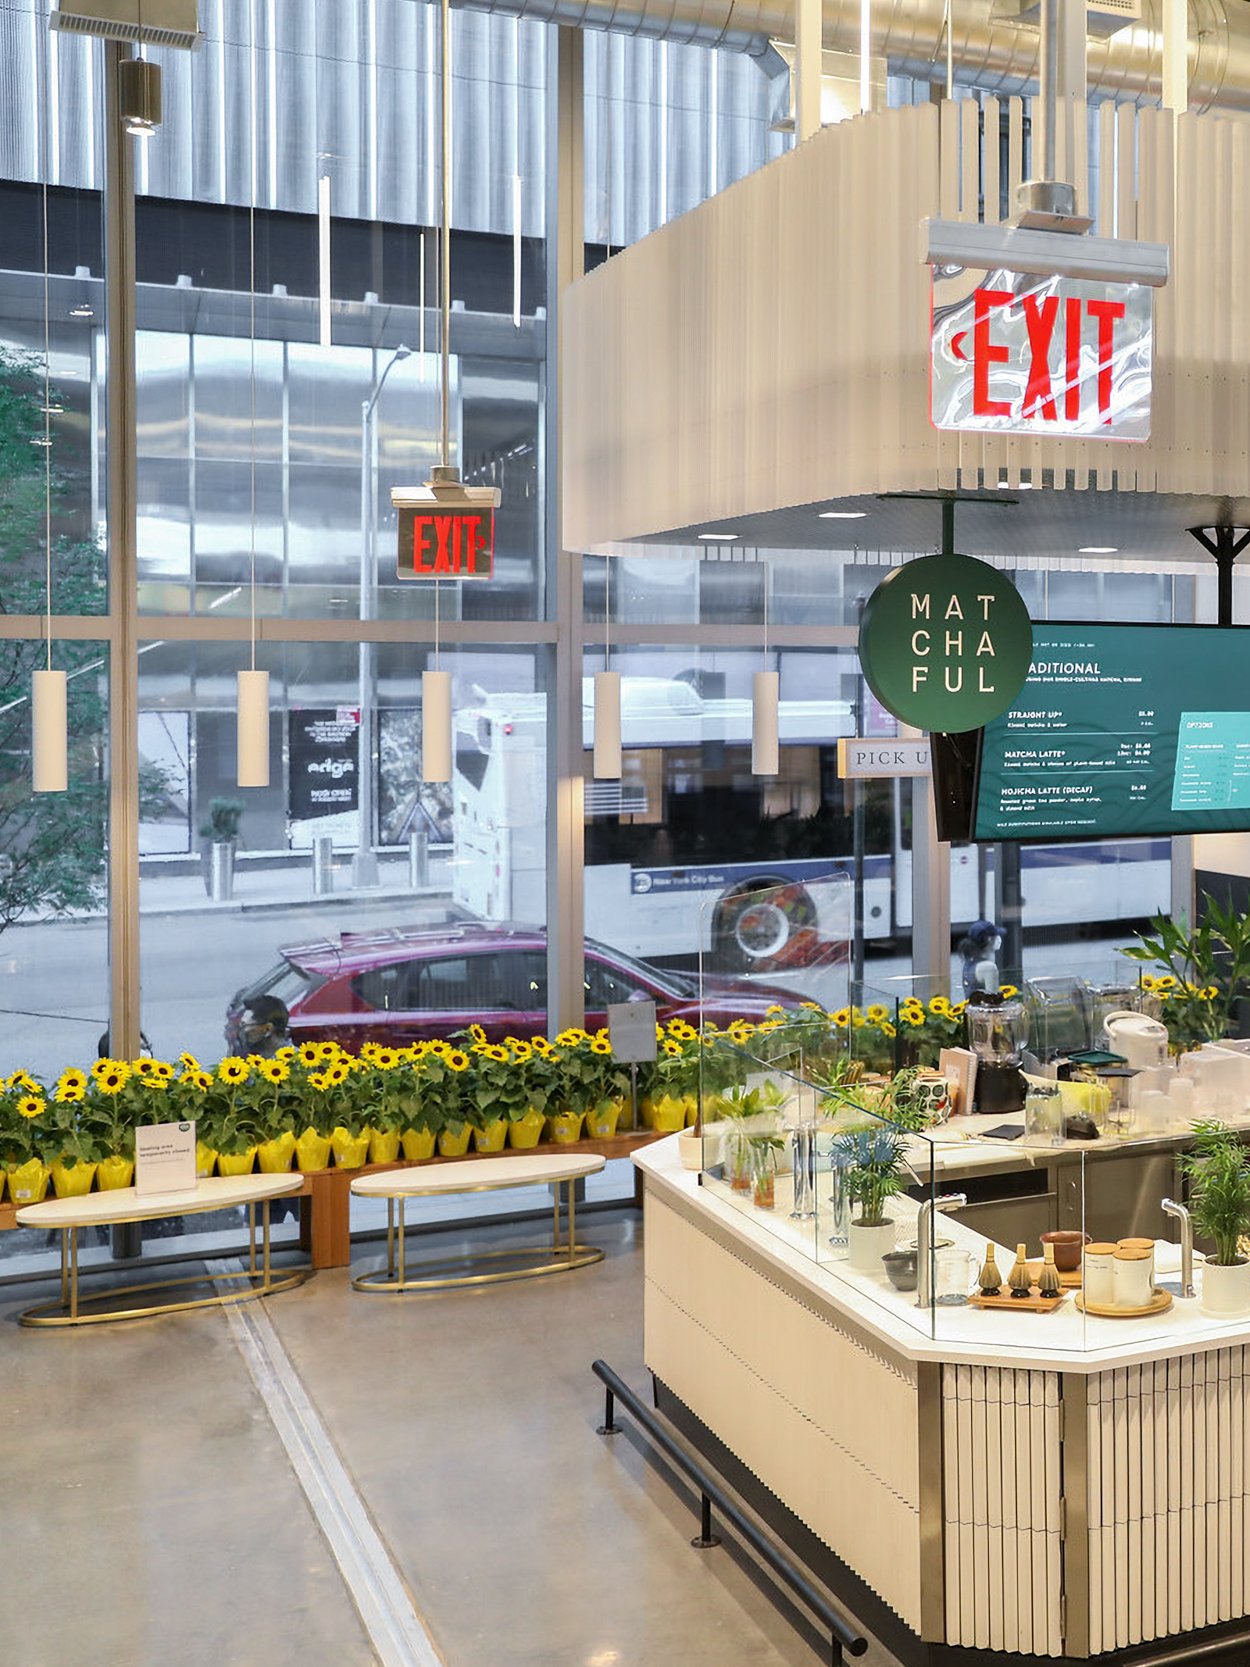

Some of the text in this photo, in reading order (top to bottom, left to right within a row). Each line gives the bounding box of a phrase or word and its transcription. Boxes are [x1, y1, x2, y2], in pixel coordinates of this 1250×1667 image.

[973, 288, 1126, 425] EXIT
[414, 515, 482, 574] EXIT
[911, 593, 995, 621] MAT
[911, 630, 996, 657] CHA
[1028, 661, 1101, 674] ADITIONAL
[912, 666, 995, 693] FUL
[1007, 711, 1046, 720] STRAIGHT
[857, 751, 928, 765] PICK U
[1004, 750, 1037, 759] MATCHA
[1001, 787, 1036, 796] HOJICHA
[1037, 787, 1061, 795] LATTE
